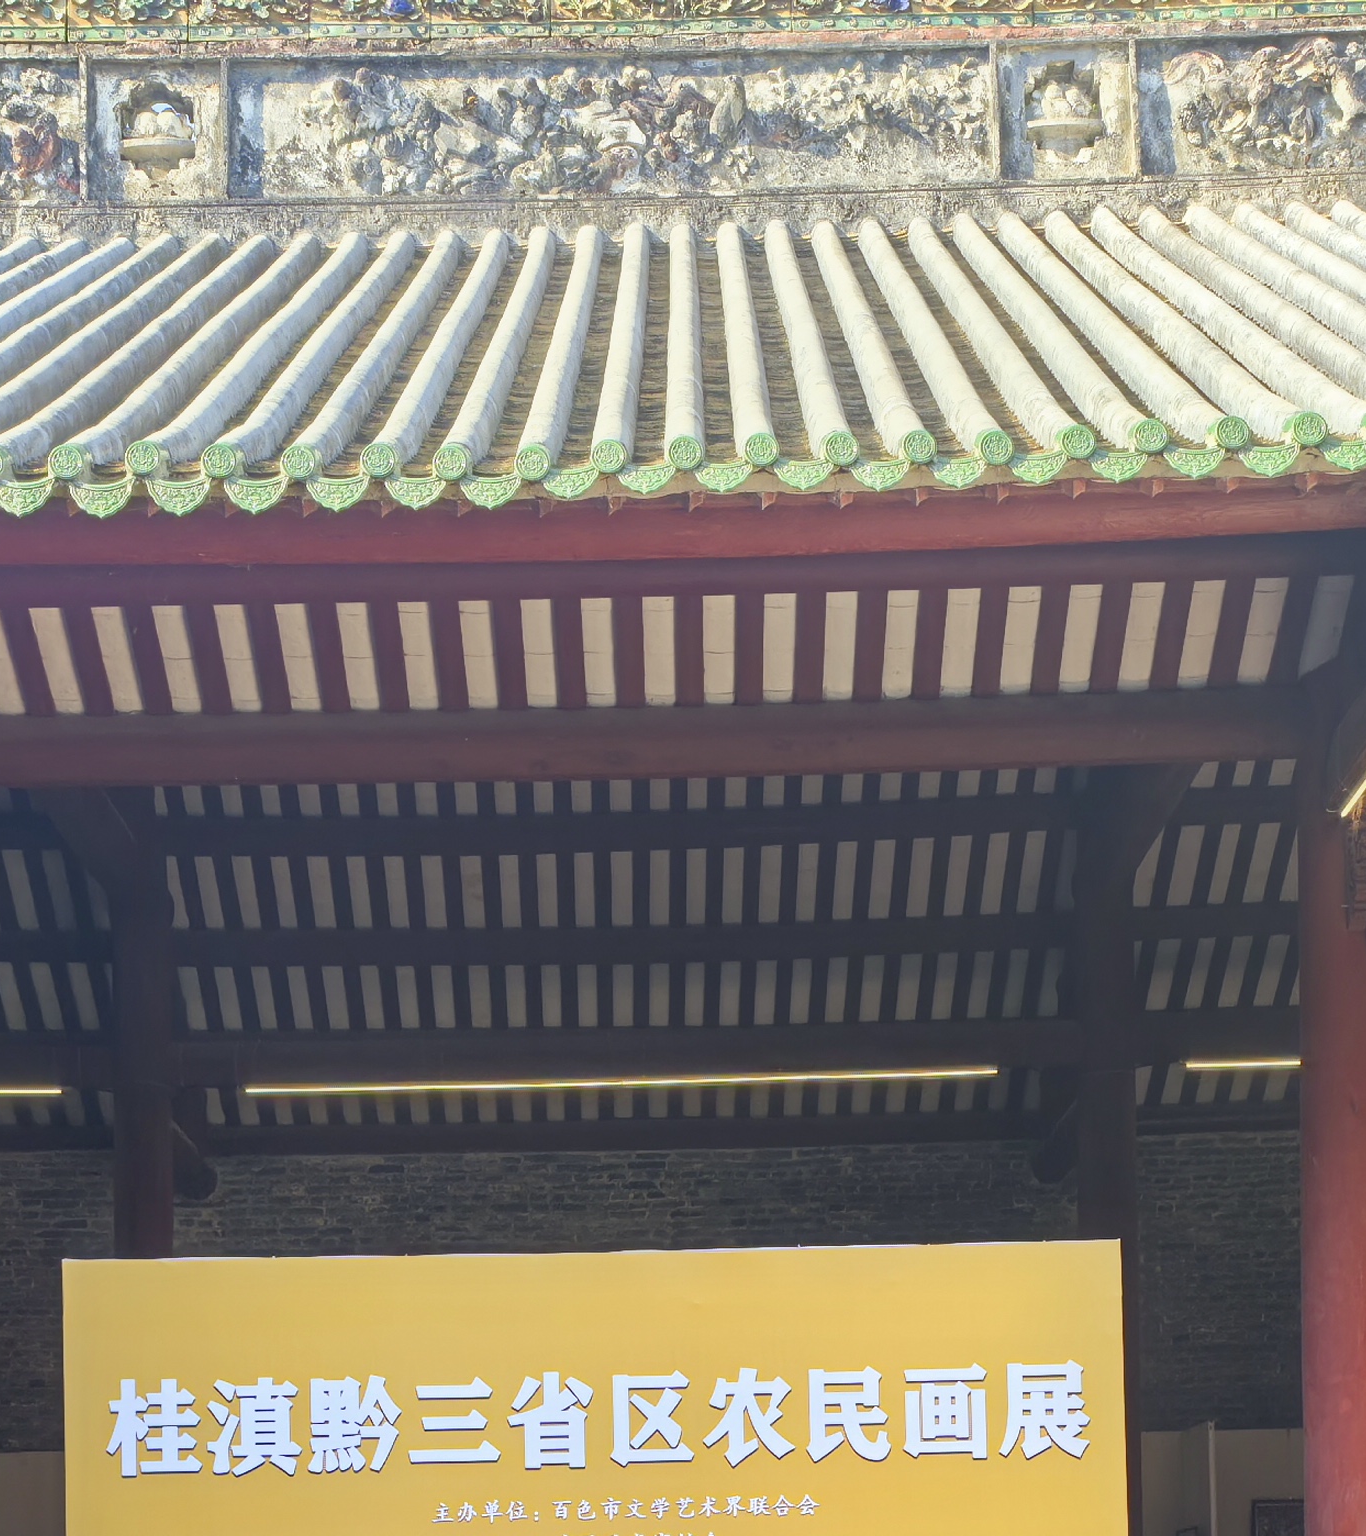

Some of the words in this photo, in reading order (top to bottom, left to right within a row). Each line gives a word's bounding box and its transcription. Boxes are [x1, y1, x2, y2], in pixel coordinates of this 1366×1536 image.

[106, 1358, 1091, 1478] 桂滇黔三省区农民画展
